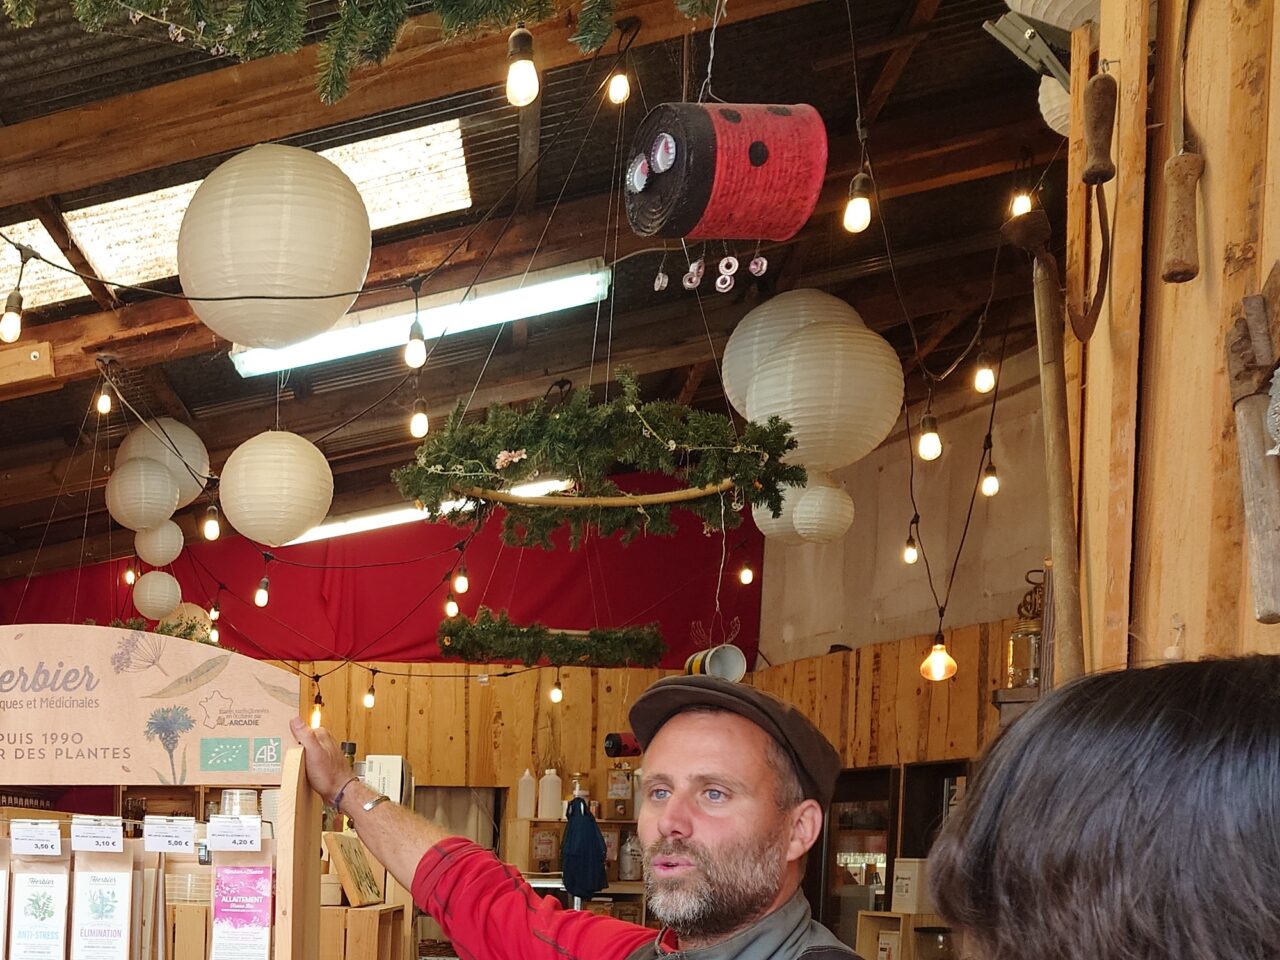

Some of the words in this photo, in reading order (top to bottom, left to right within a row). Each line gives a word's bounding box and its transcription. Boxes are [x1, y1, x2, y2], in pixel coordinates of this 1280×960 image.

[26, 698, 38, 709] et
[39, 696, 100, 709] Médicinales
[41, 732, 84, 745] 1990
[14, 748, 46, 760] DES
[55, 747, 132, 760] PLANTES
[255, 745, 277, 762] AB
